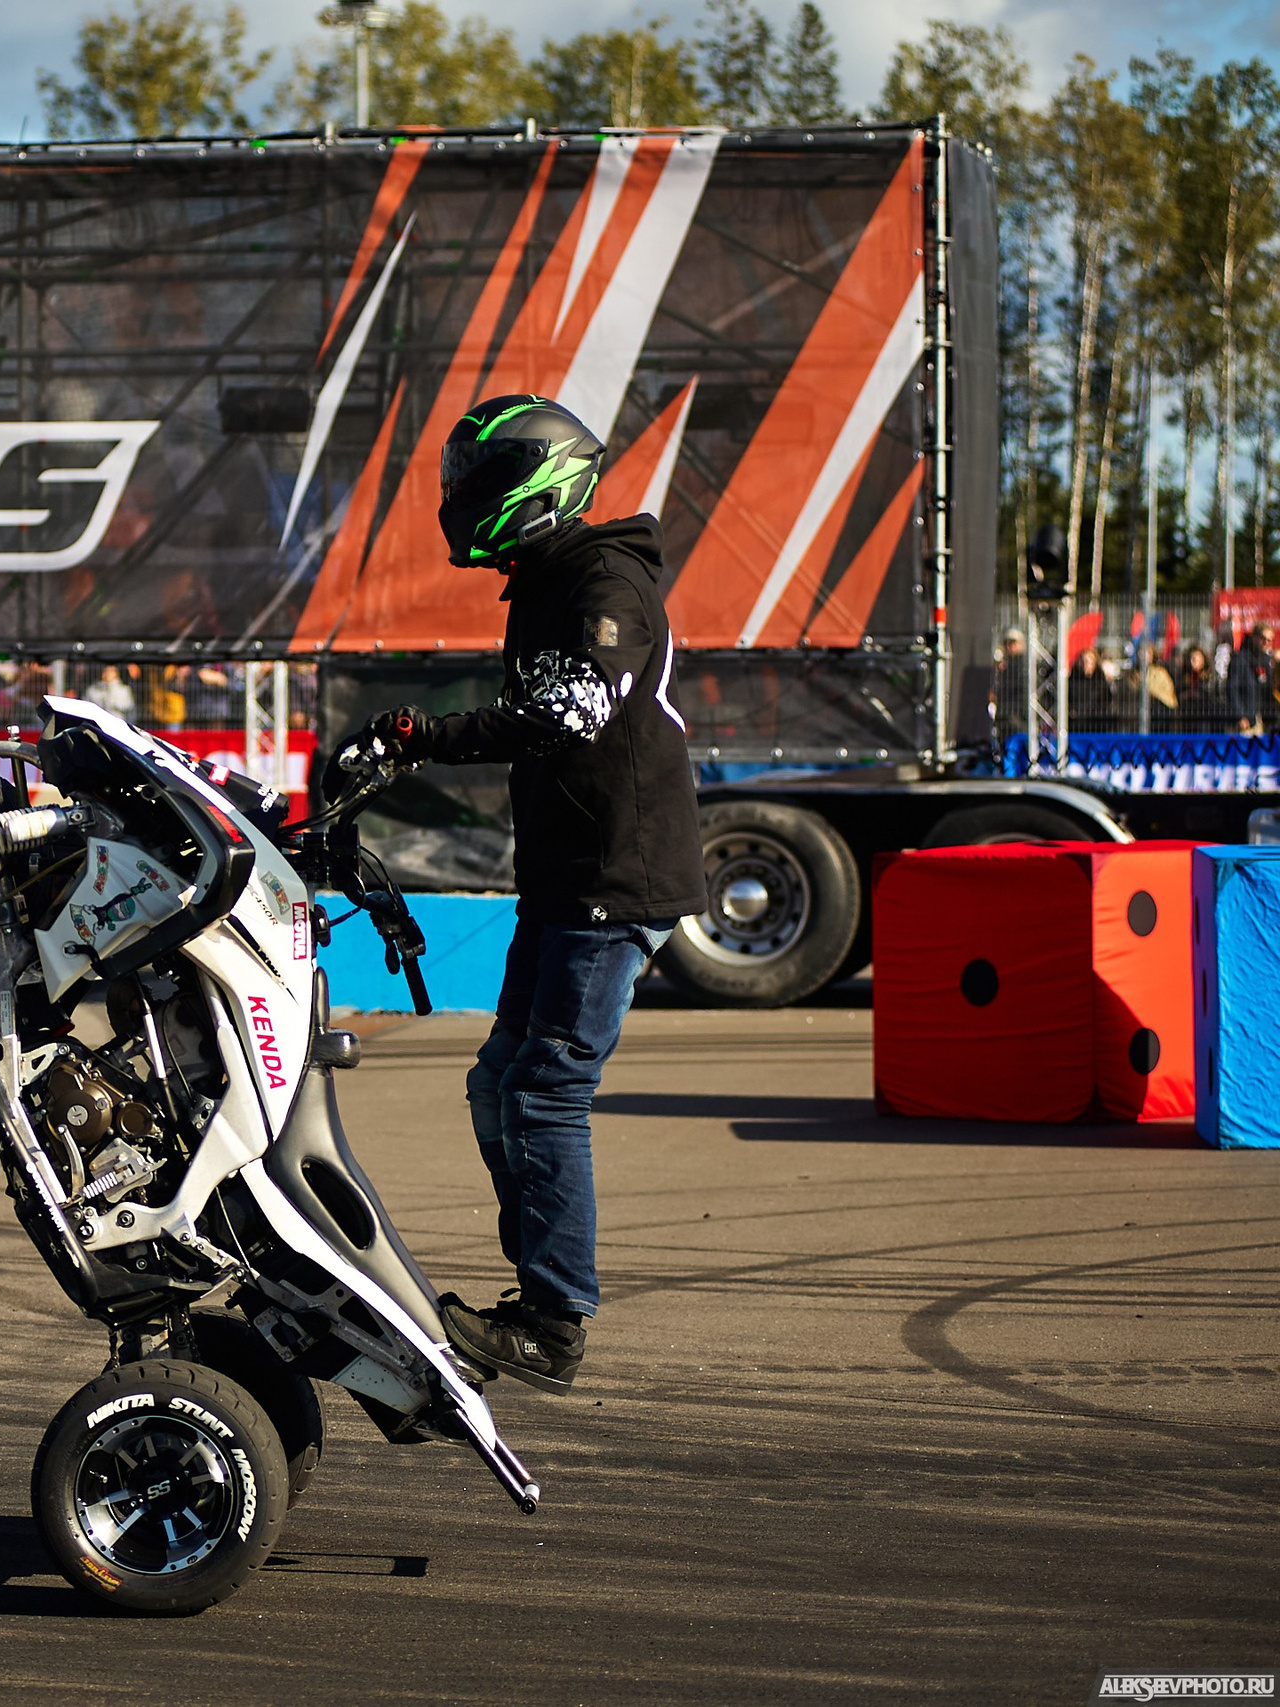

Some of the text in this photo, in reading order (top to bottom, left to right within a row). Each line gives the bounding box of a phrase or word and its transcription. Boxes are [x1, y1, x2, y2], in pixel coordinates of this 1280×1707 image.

[293, 904, 306, 959] MOTUL
[247, 995, 287, 1090] KENDA
[86, 1393, 258, 1542] NIKITA STUNT MOSCOW
